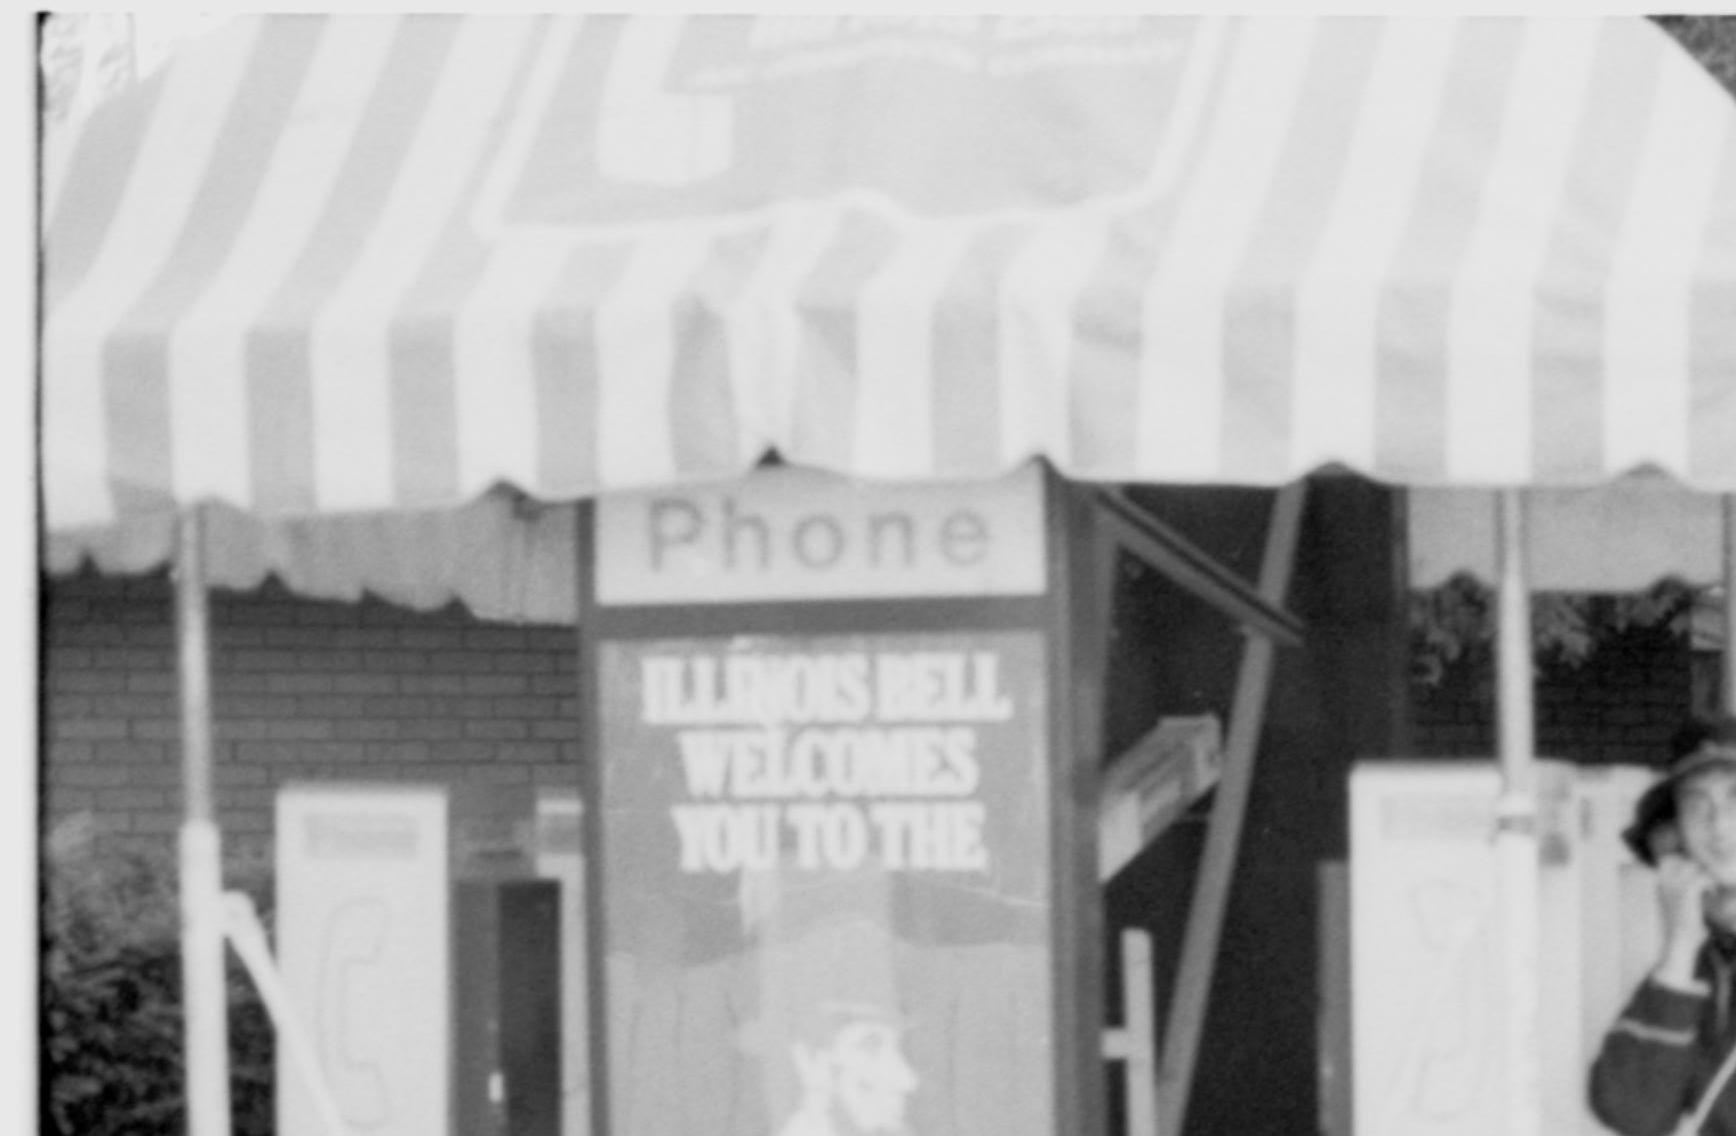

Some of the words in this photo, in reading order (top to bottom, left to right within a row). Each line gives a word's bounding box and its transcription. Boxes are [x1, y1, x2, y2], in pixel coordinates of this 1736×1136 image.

[650, 499, 989, 571] Phone
[641, 653, 870, 725] ILLINOIS
[877, 652, 1013, 722] BELL
[677, 726, 980, 797] WELCOMES
[671, 802, 779, 872] YOU
[786, 802, 867, 871] TO
[870, 801, 989, 871] THE
